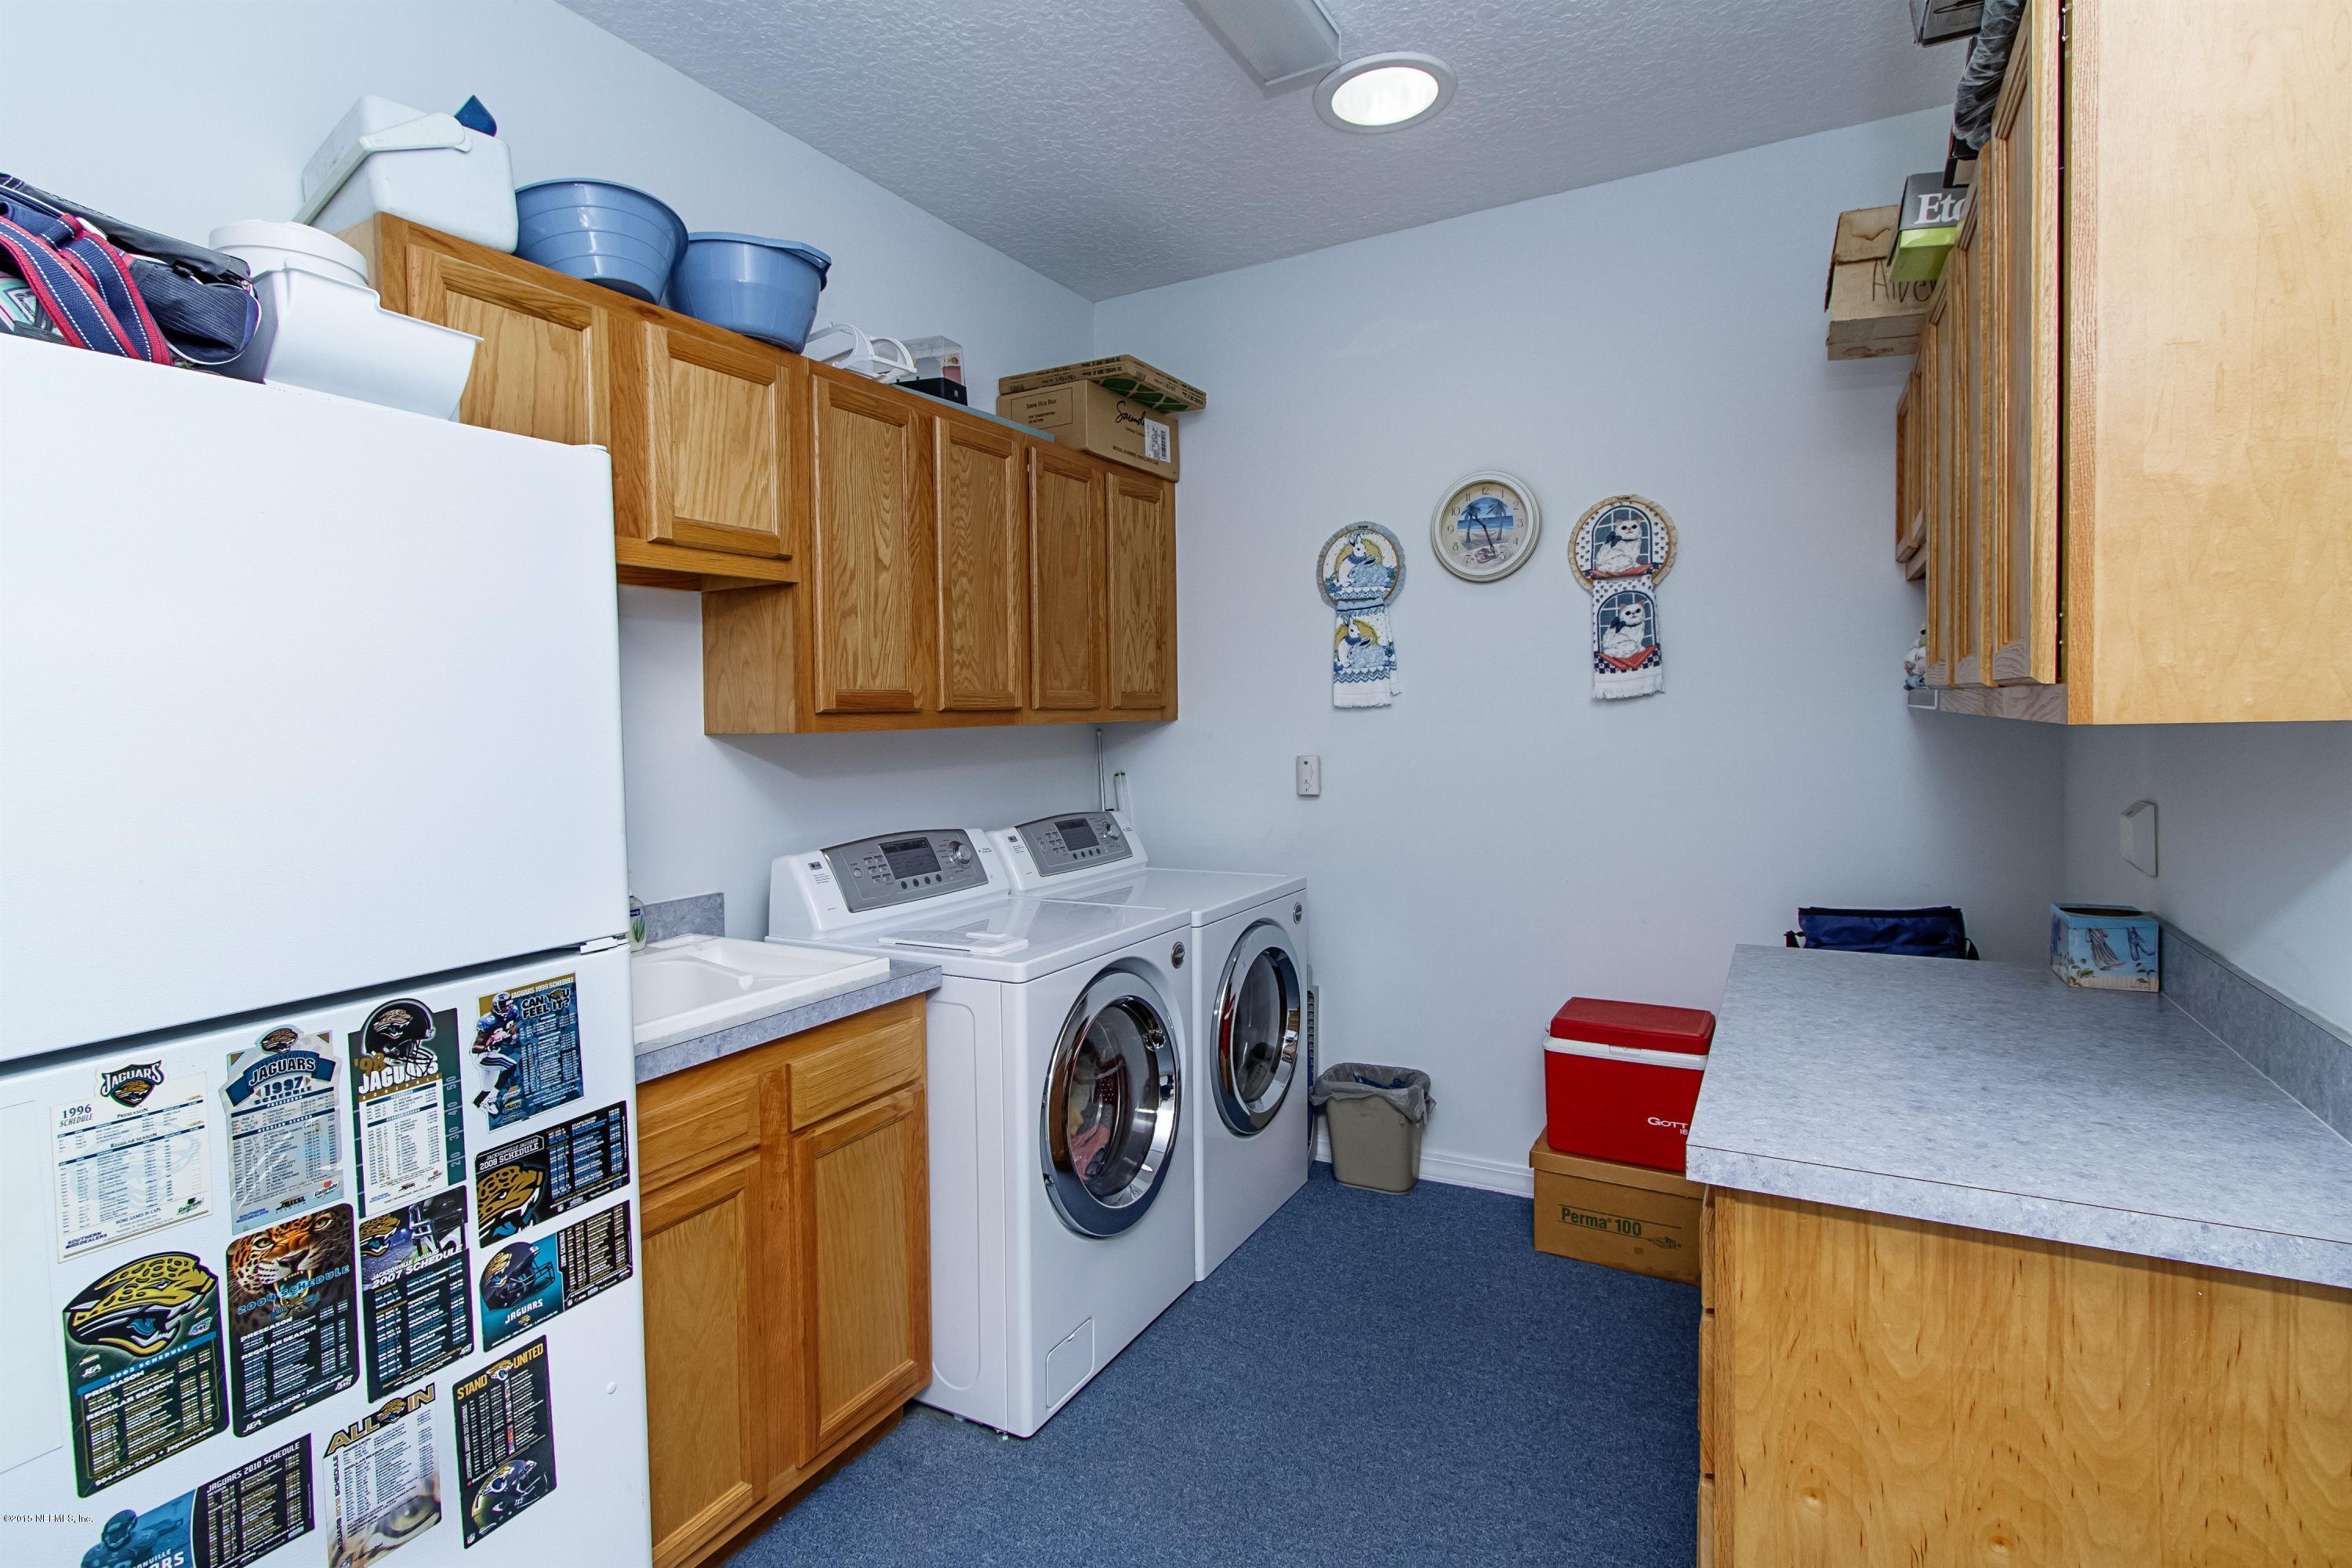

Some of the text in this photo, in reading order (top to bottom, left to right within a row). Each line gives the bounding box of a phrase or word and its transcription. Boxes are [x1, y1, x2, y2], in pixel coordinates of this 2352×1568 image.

[1115, 401, 1146, 426] Saund
[1466, 493, 1471, 502] 11
[1482, 487, 1490, 495] 12
[1451, 506, 1460, 516] 10
[1513, 501, 1519, 510] 2
[1516, 519, 1524, 528] 3
[1466, 554, 1471, 564] 7
[510, 977, 575, 999] JAGUARS 1999 SCHEDULE
[522, 988, 571, 1009] CAN YU
[522, 997, 571, 1019] FEEL IT?
[249, 1057, 315, 1087] JAGUARS
[353, 1052, 387, 1077] '98
[100, 1060, 165, 1097] JAGUARS
[264, 1076, 304, 1097] 1997
[358, 1061, 439, 1094] JAGUARS
[445, 1076, 456, 1091] 50
[253, 1085, 312, 1105] SCHEDULE
[63, 1104, 93, 1119] 1996
[117, 1107, 149, 1119] PRESEASON
[447, 1101, 458, 1116] 40
[60, 1113, 93, 1127] SCHEDULE
[1647, 1116, 1689, 1130] GOTT
[449, 1126, 459, 1142] 30
[451, 1152, 461, 1167] 20
[479, 1143, 539, 1171] 2008 SCHEDULE
[485, 1137, 539, 1162] JACKSONVILLE JAGUARS
[67, 1231, 102, 1245] SOUTHERN
[1615, 1218, 1642, 1237] 100
[371, 1259, 413, 1281] JACKSONVILLE
[372, 1243, 463, 1289] 2007 SCHEDULE
[238, 1294, 278, 1316] 2004
[279, 1265, 350, 1298] SCHEDULE
[505, 1298, 544, 1324] JAGUARS
[240, 1316, 293, 1343] PRESEASON
[241, 1324, 317, 1361] REGULAR SEASON
[82, 1364, 102, 1377] JEA
[110, 1345, 187, 1381] 2003 SCHEDULE
[457, 1342, 544, 1400] STAND UNITED
[84, 1370, 144, 1400] PRESEASON
[86, 1378, 174, 1421] REGULAR SEASON
[243, 1419, 262, 1433] JEA
[327, 1385, 435, 1455] ALL IN
[94, 1427, 214, 1486] 904-633-2000 jaguars.com
[207, 1441, 301, 1494] JAGUARS 2010 SCHEDULE
